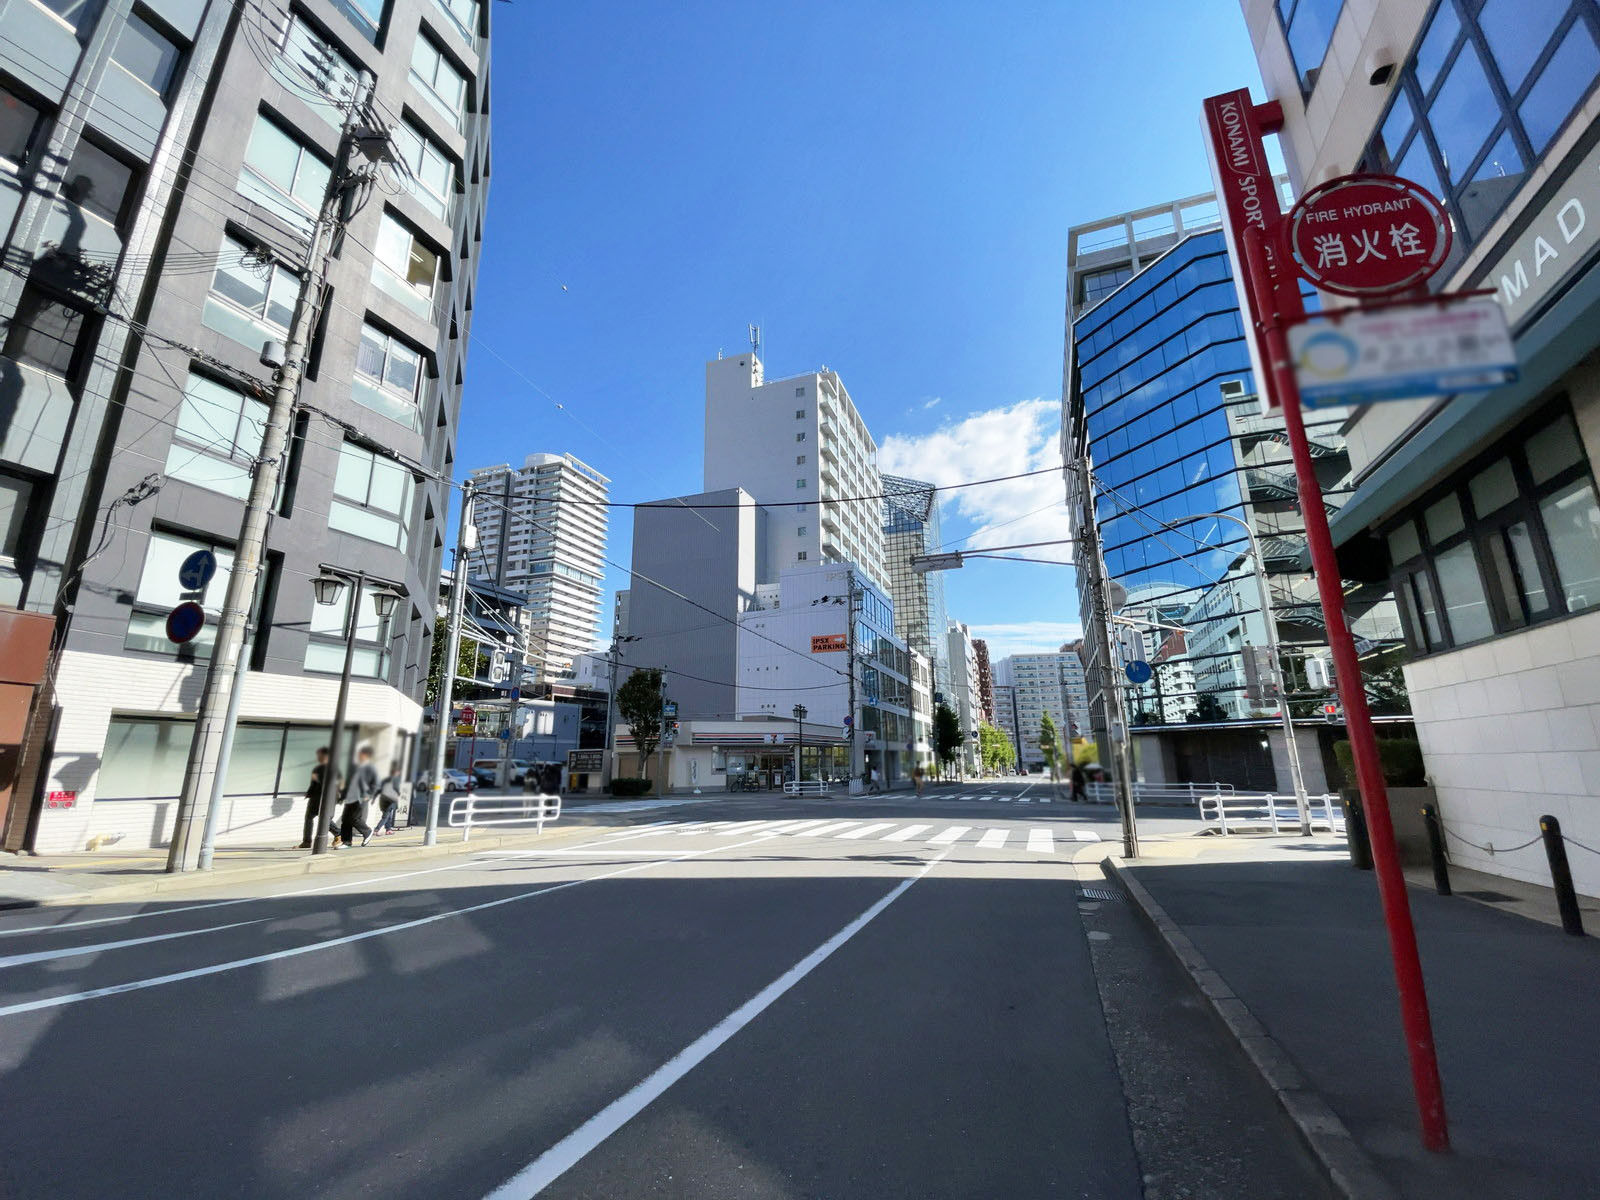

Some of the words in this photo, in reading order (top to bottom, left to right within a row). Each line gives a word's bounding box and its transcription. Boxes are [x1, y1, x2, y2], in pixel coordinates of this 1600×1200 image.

[1221, 101, 1250, 167] KONAMI
[1238, 176, 1266, 232] SPORT
[1306, 209, 1339, 224] FIRE
[1343, 197, 1413, 219] HYDRANT
[1313, 222, 1427, 269] 消火栓
[1492, 198, 1586, 305] MAD
[813, 637, 830, 645] IPSX
[813, 643, 846, 651] PARKING
